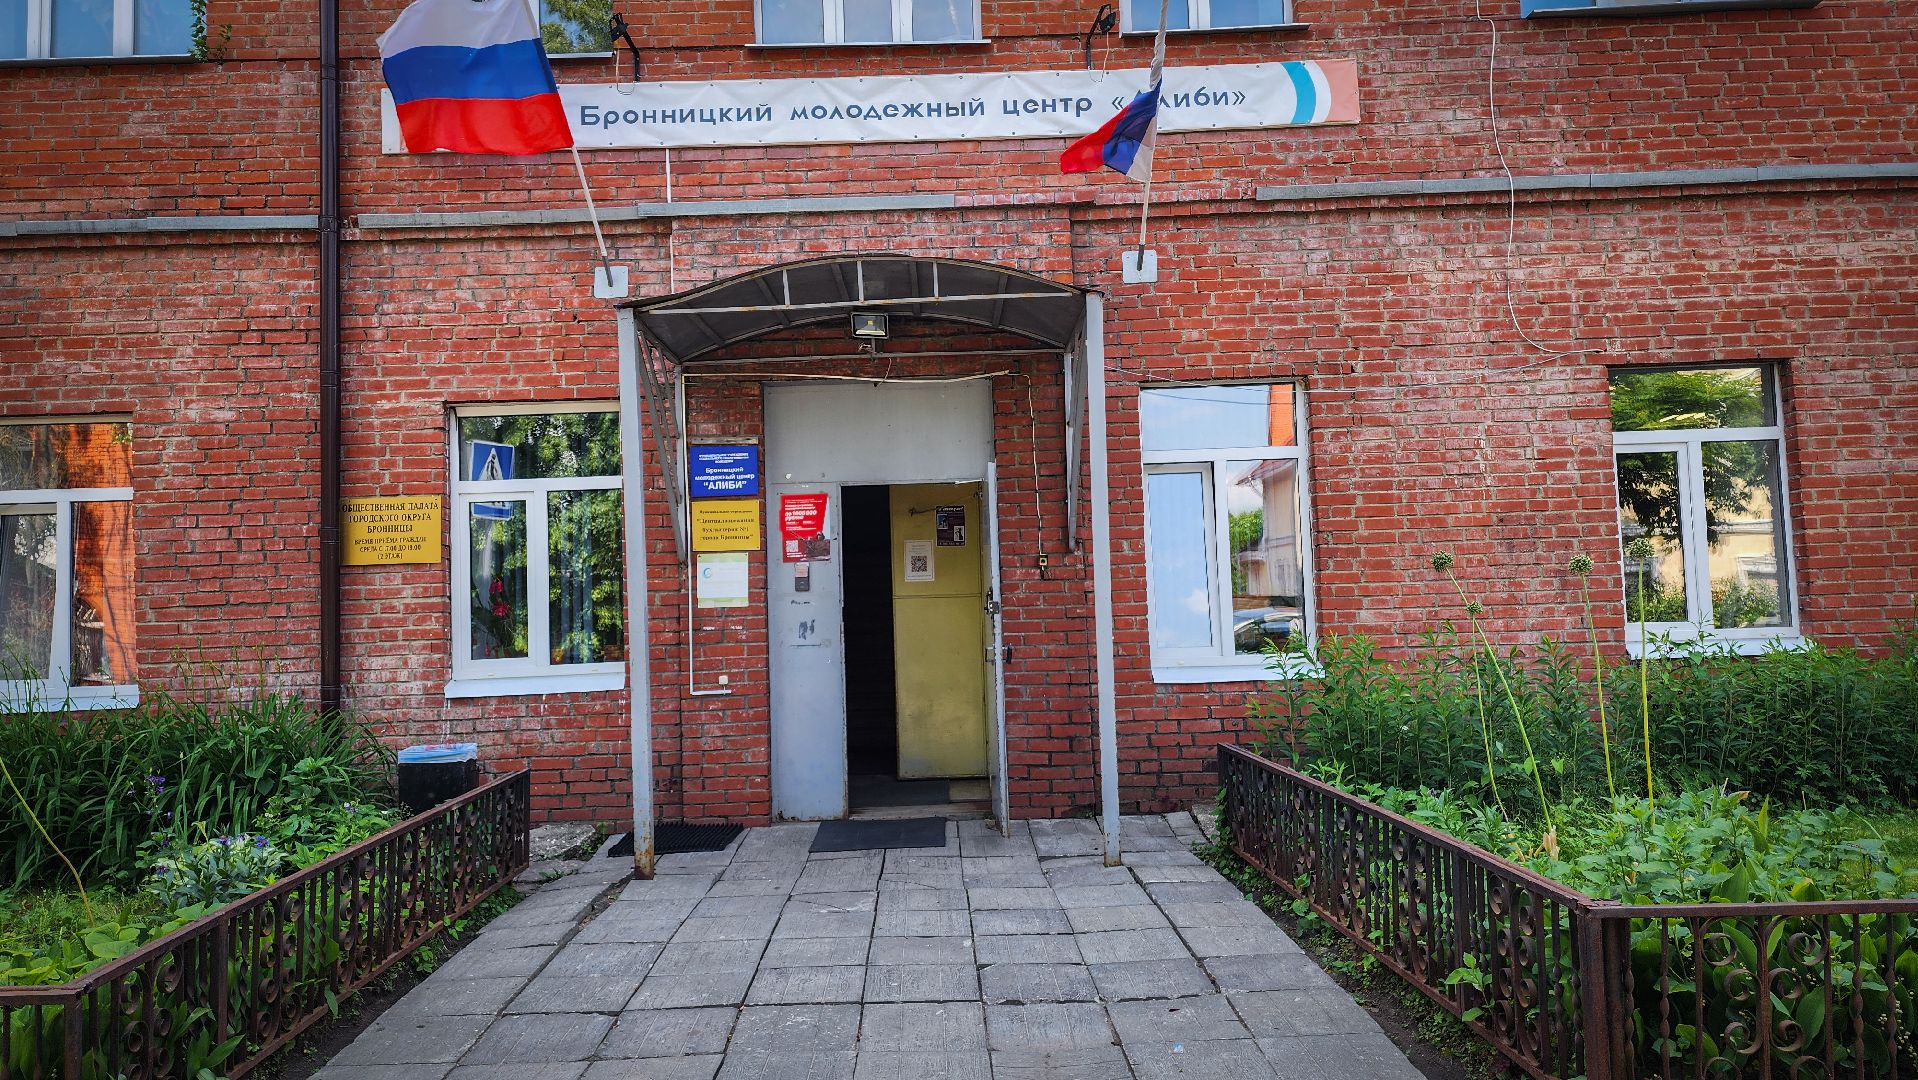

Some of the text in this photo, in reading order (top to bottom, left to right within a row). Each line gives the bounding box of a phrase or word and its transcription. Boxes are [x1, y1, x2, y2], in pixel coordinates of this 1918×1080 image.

[580, 86, 1246, 129] Бронницкий молодежный центр «либи»
[705, 466, 744, 474] Бронницкий
[342, 502, 439, 512] ОБЩЕСТВЕННАЯ ПАЛАТА
[349, 512, 432, 523] ГОРОДСКОГО ОКРУГА
[367, 524, 413, 534] БРОННИЦЫ
